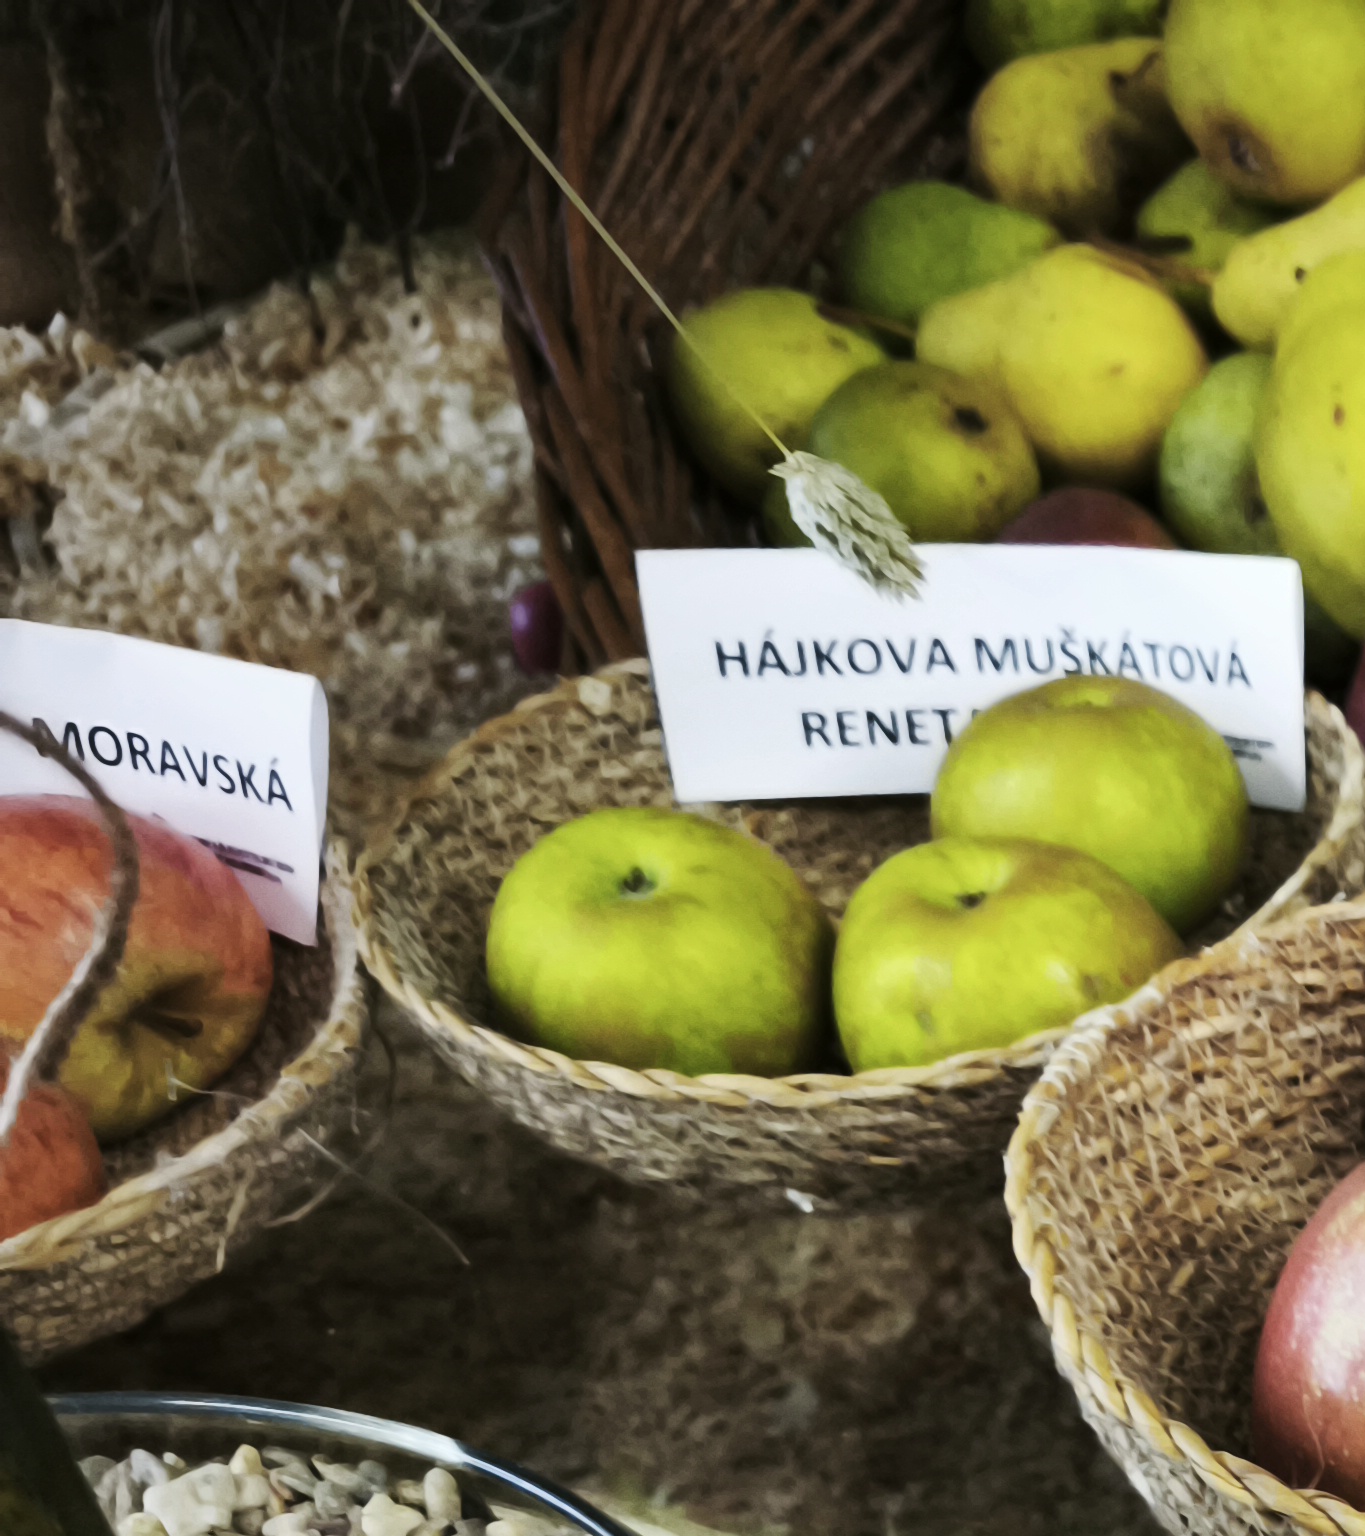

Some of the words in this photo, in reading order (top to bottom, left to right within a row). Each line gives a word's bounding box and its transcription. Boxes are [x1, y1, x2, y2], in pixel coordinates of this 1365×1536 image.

[714, 628, 957, 677] HÁJKOVA
[974, 627, 1252, 690] MUŠKÁTOVÁ
[801, 708, 983, 747] RENET
